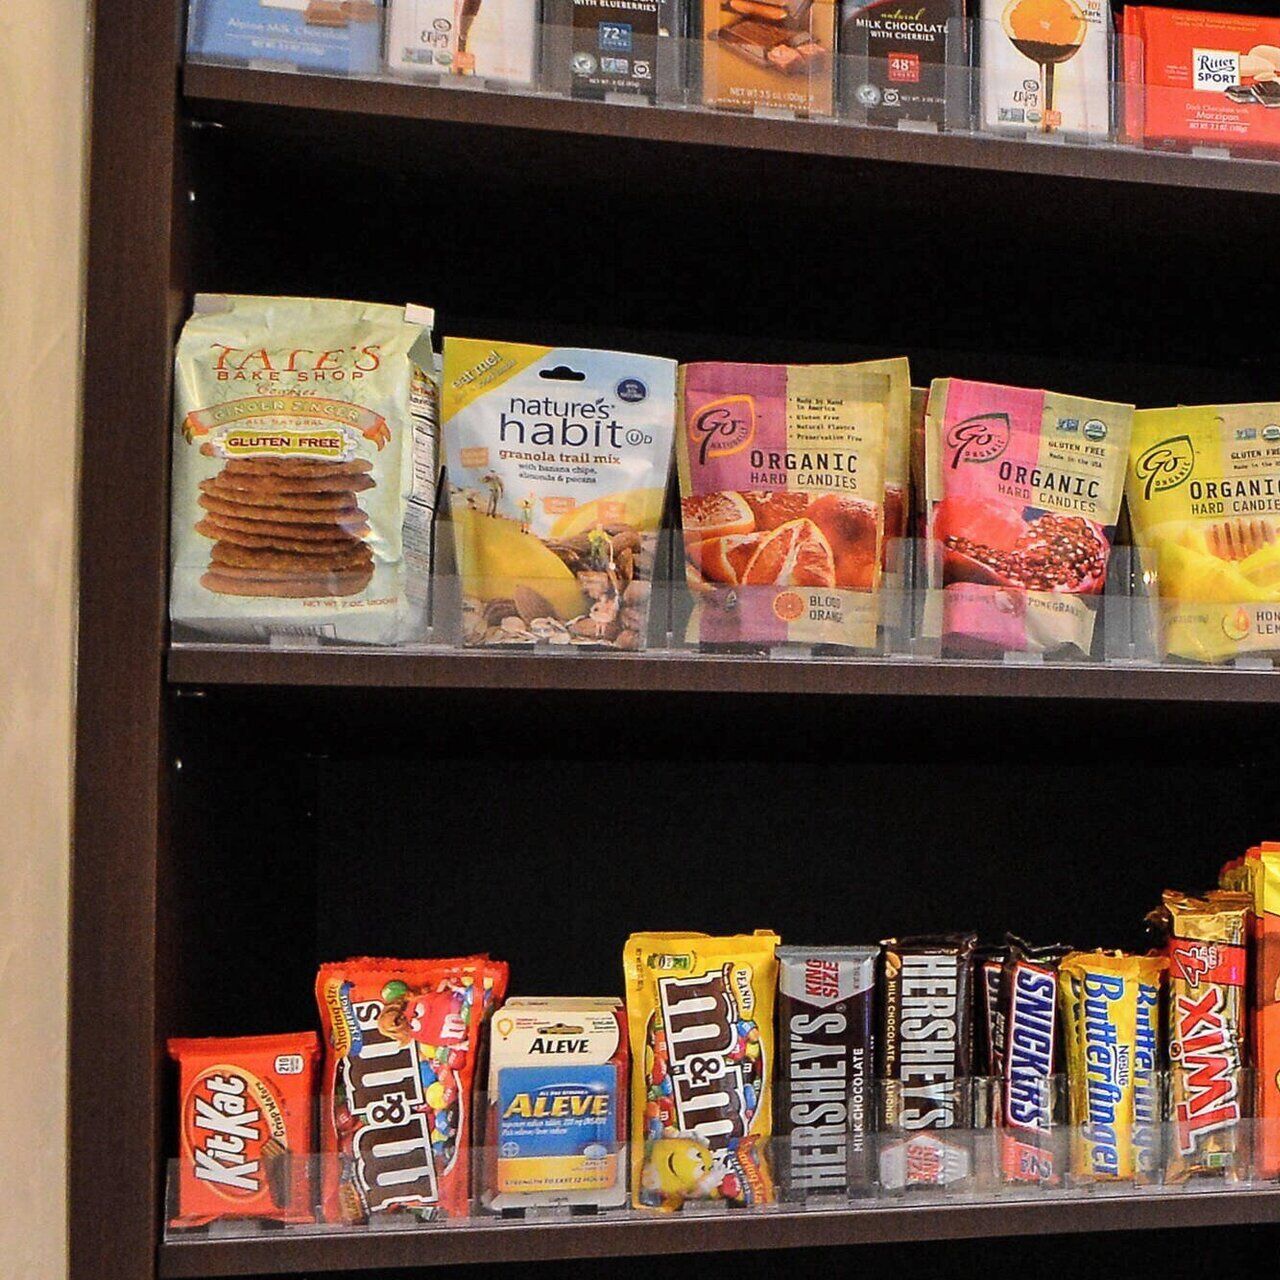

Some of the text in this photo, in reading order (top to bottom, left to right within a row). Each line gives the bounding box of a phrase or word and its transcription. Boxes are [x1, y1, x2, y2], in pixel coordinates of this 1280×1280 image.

[855, 19, 881, 30] MILK
[1198, 55, 1236, 73] Ritter
[1198, 72, 1236, 84] SPORT
[217, 371, 363, 382] BAKE SHOP
[511, 397, 610, 419] nature's
[229, 437, 340, 448] GLUTEN FREE
[500, 413, 623, 448] habit
[499, 449, 621, 464] granola trail mix
[538, 465, 570, 474] banana
[751, 450, 857, 473] ORGANIC
[751, 472, 857, 489] HARD CANDIES
[1000, 461, 1099, 498] ORGANIC
[998, 484, 1096, 513] HARD CANDIES
[1191, 501, 1226, 514] HARD
[737, 969, 752, 1010] PEANUT
[805, 960, 821, 997] KING
[822, 960, 839, 998] SIZE
[529, 1038, 589, 1055] ALEVE
[901, 955, 958, 1130] HERSHEY'S
[1011, 969, 1054, 1129] SNICKERS
[853, 1047, 864, 1119] CHOCOLATE
[1085, 973, 1124, 1177] Butterfinger
[1176, 985, 1241, 1156] TWIX
[503, 1093, 609, 1120] ALEVE
[790, 1012, 848, 1189] HERSHEY'S
